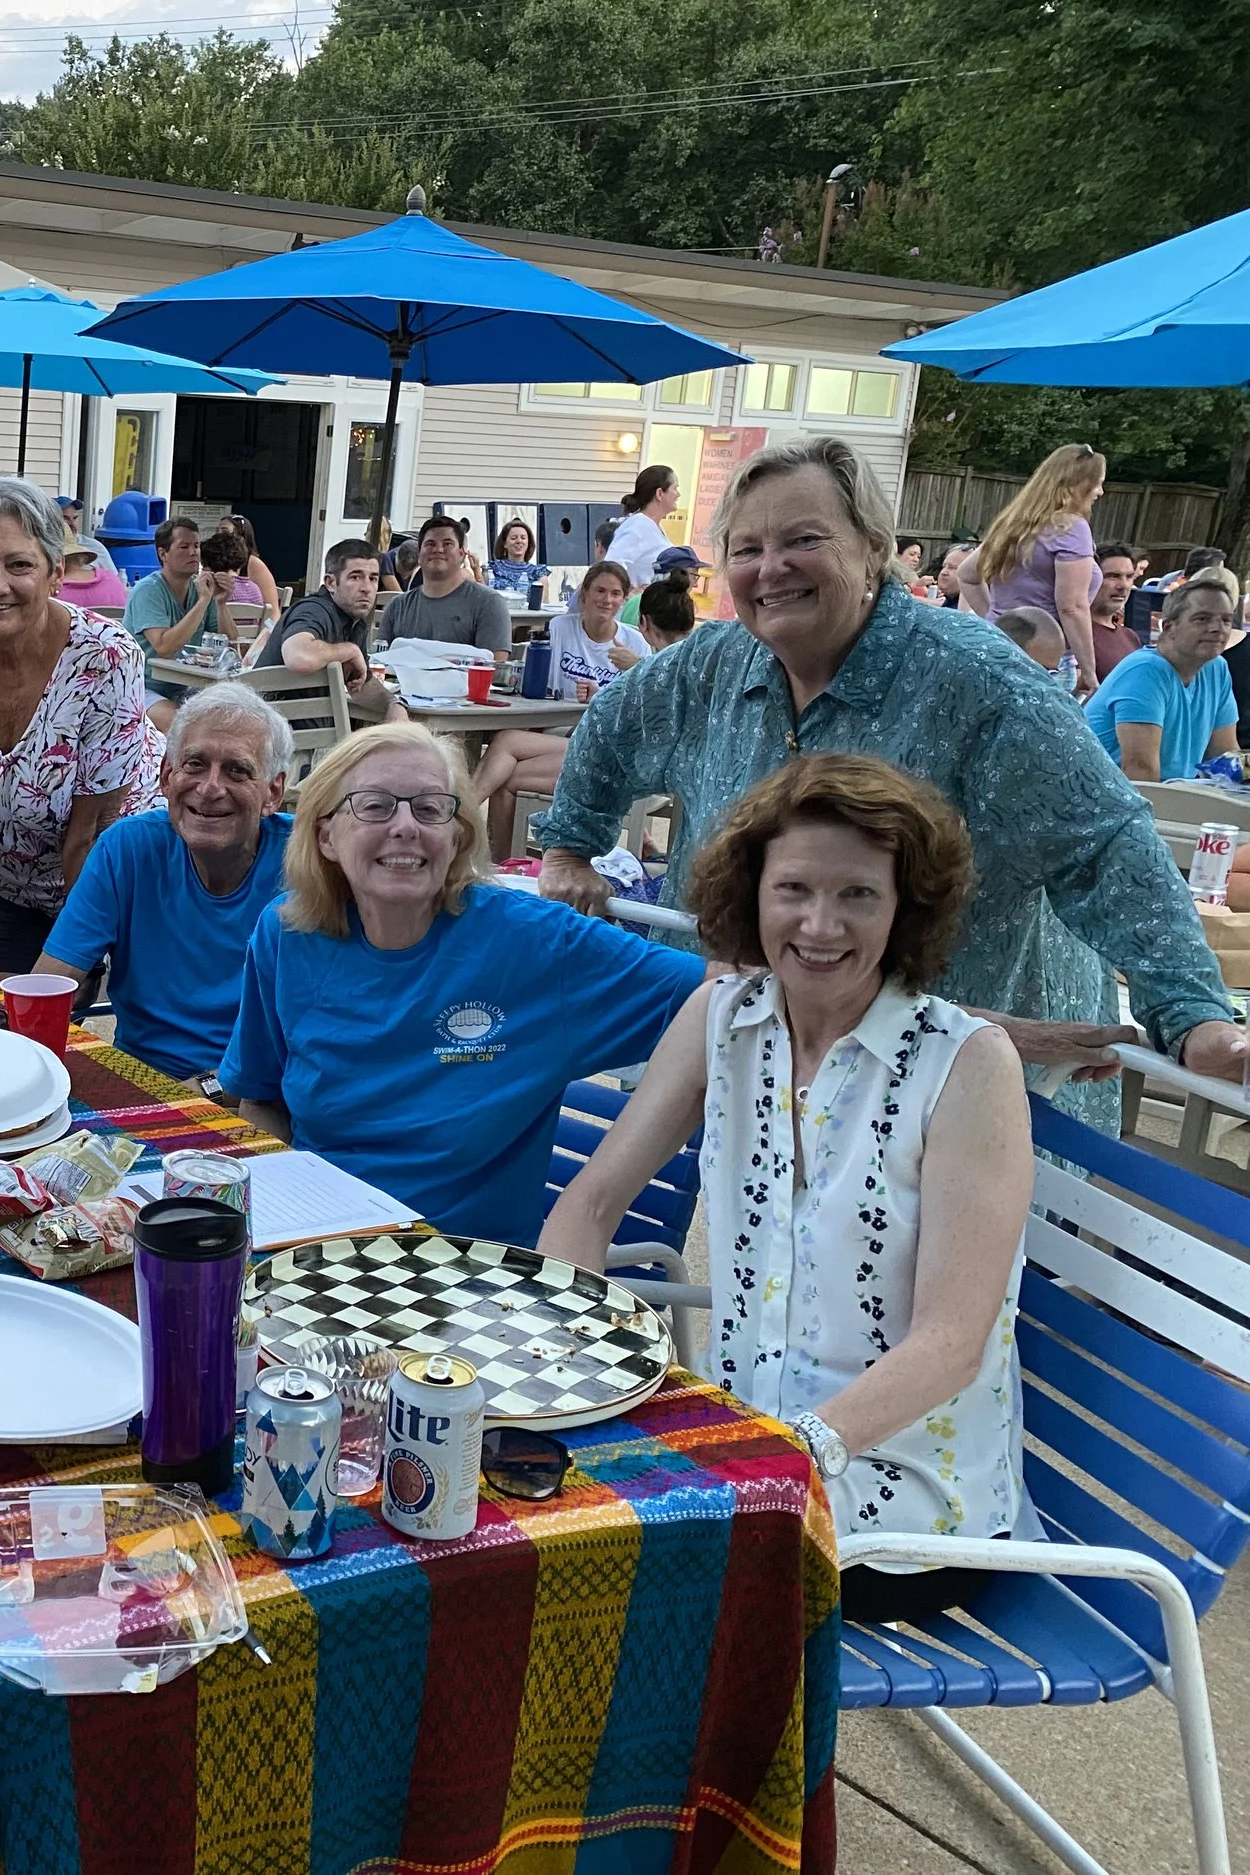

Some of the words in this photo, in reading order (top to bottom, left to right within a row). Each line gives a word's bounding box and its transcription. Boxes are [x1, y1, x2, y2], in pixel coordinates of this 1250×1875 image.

[704, 449, 733, 458] WOMEN
[433, 1003, 462, 1027] SLEEPY
[465, 1001, 507, 1022] HOLLOW
[433, 1045, 487, 1055] SWIM-A-THON
[488, 1044, 507, 1053] 2022
[440, 1054, 473, 1064] SHINE
[476, 1053, 494, 1062] ON
[388, 1390, 451, 1446] Lite
